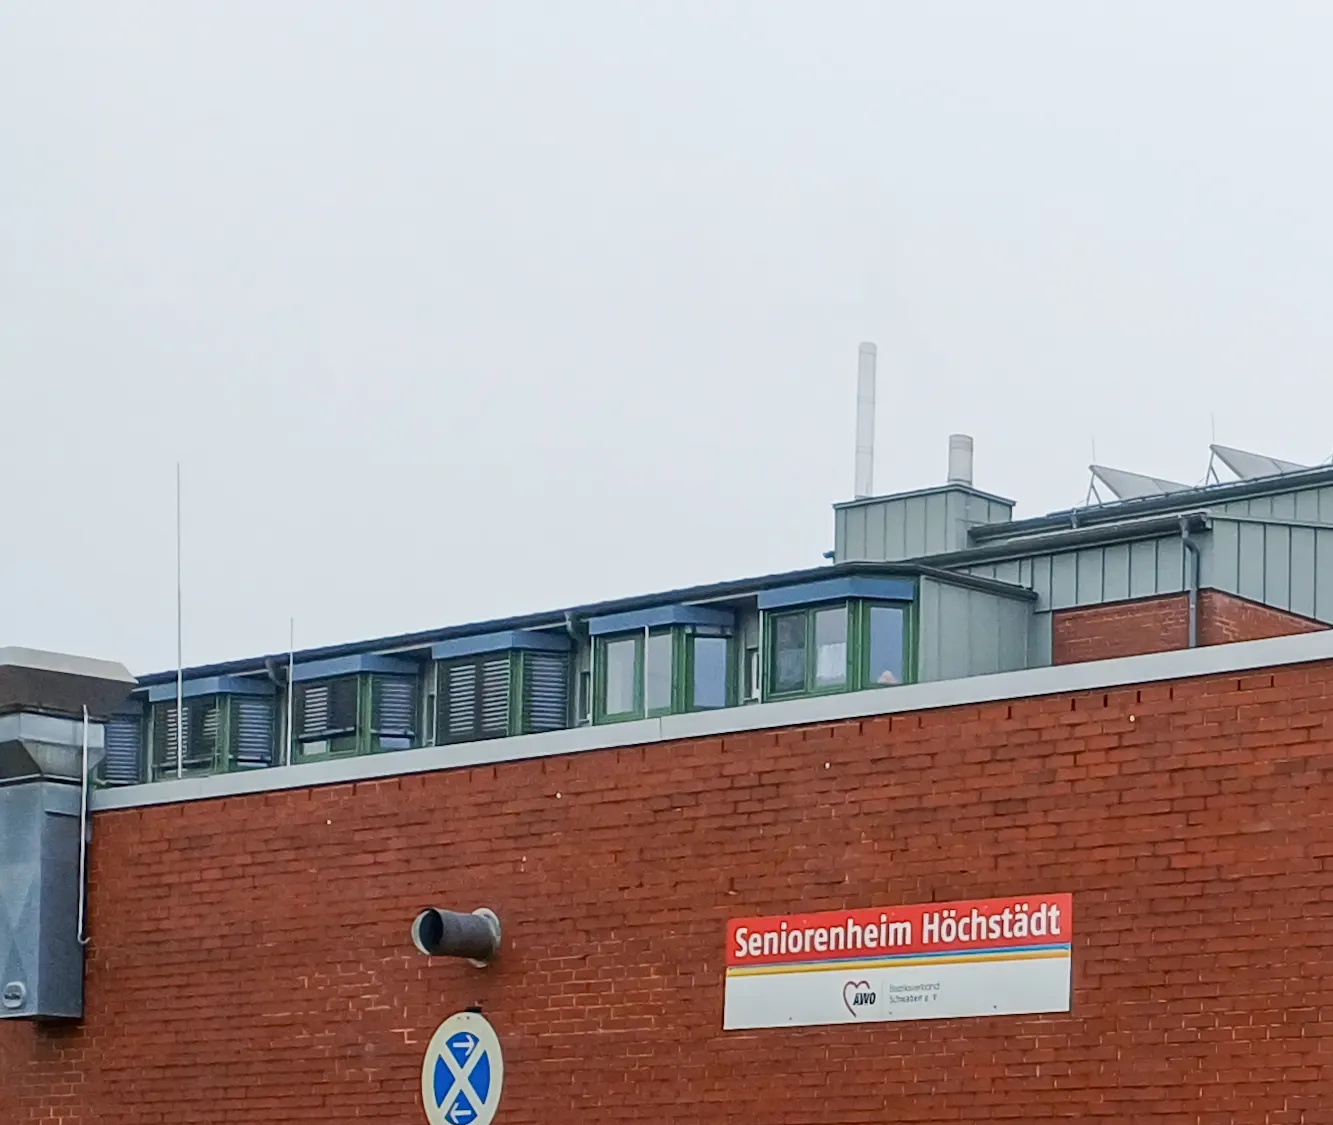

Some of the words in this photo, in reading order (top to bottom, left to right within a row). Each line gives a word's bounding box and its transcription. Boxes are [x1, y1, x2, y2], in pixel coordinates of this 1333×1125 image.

[735, 914, 912, 957] Seniorenheim
[922, 903, 1061, 943] Höchstädt
[853, 992, 876, 1005] AWO
